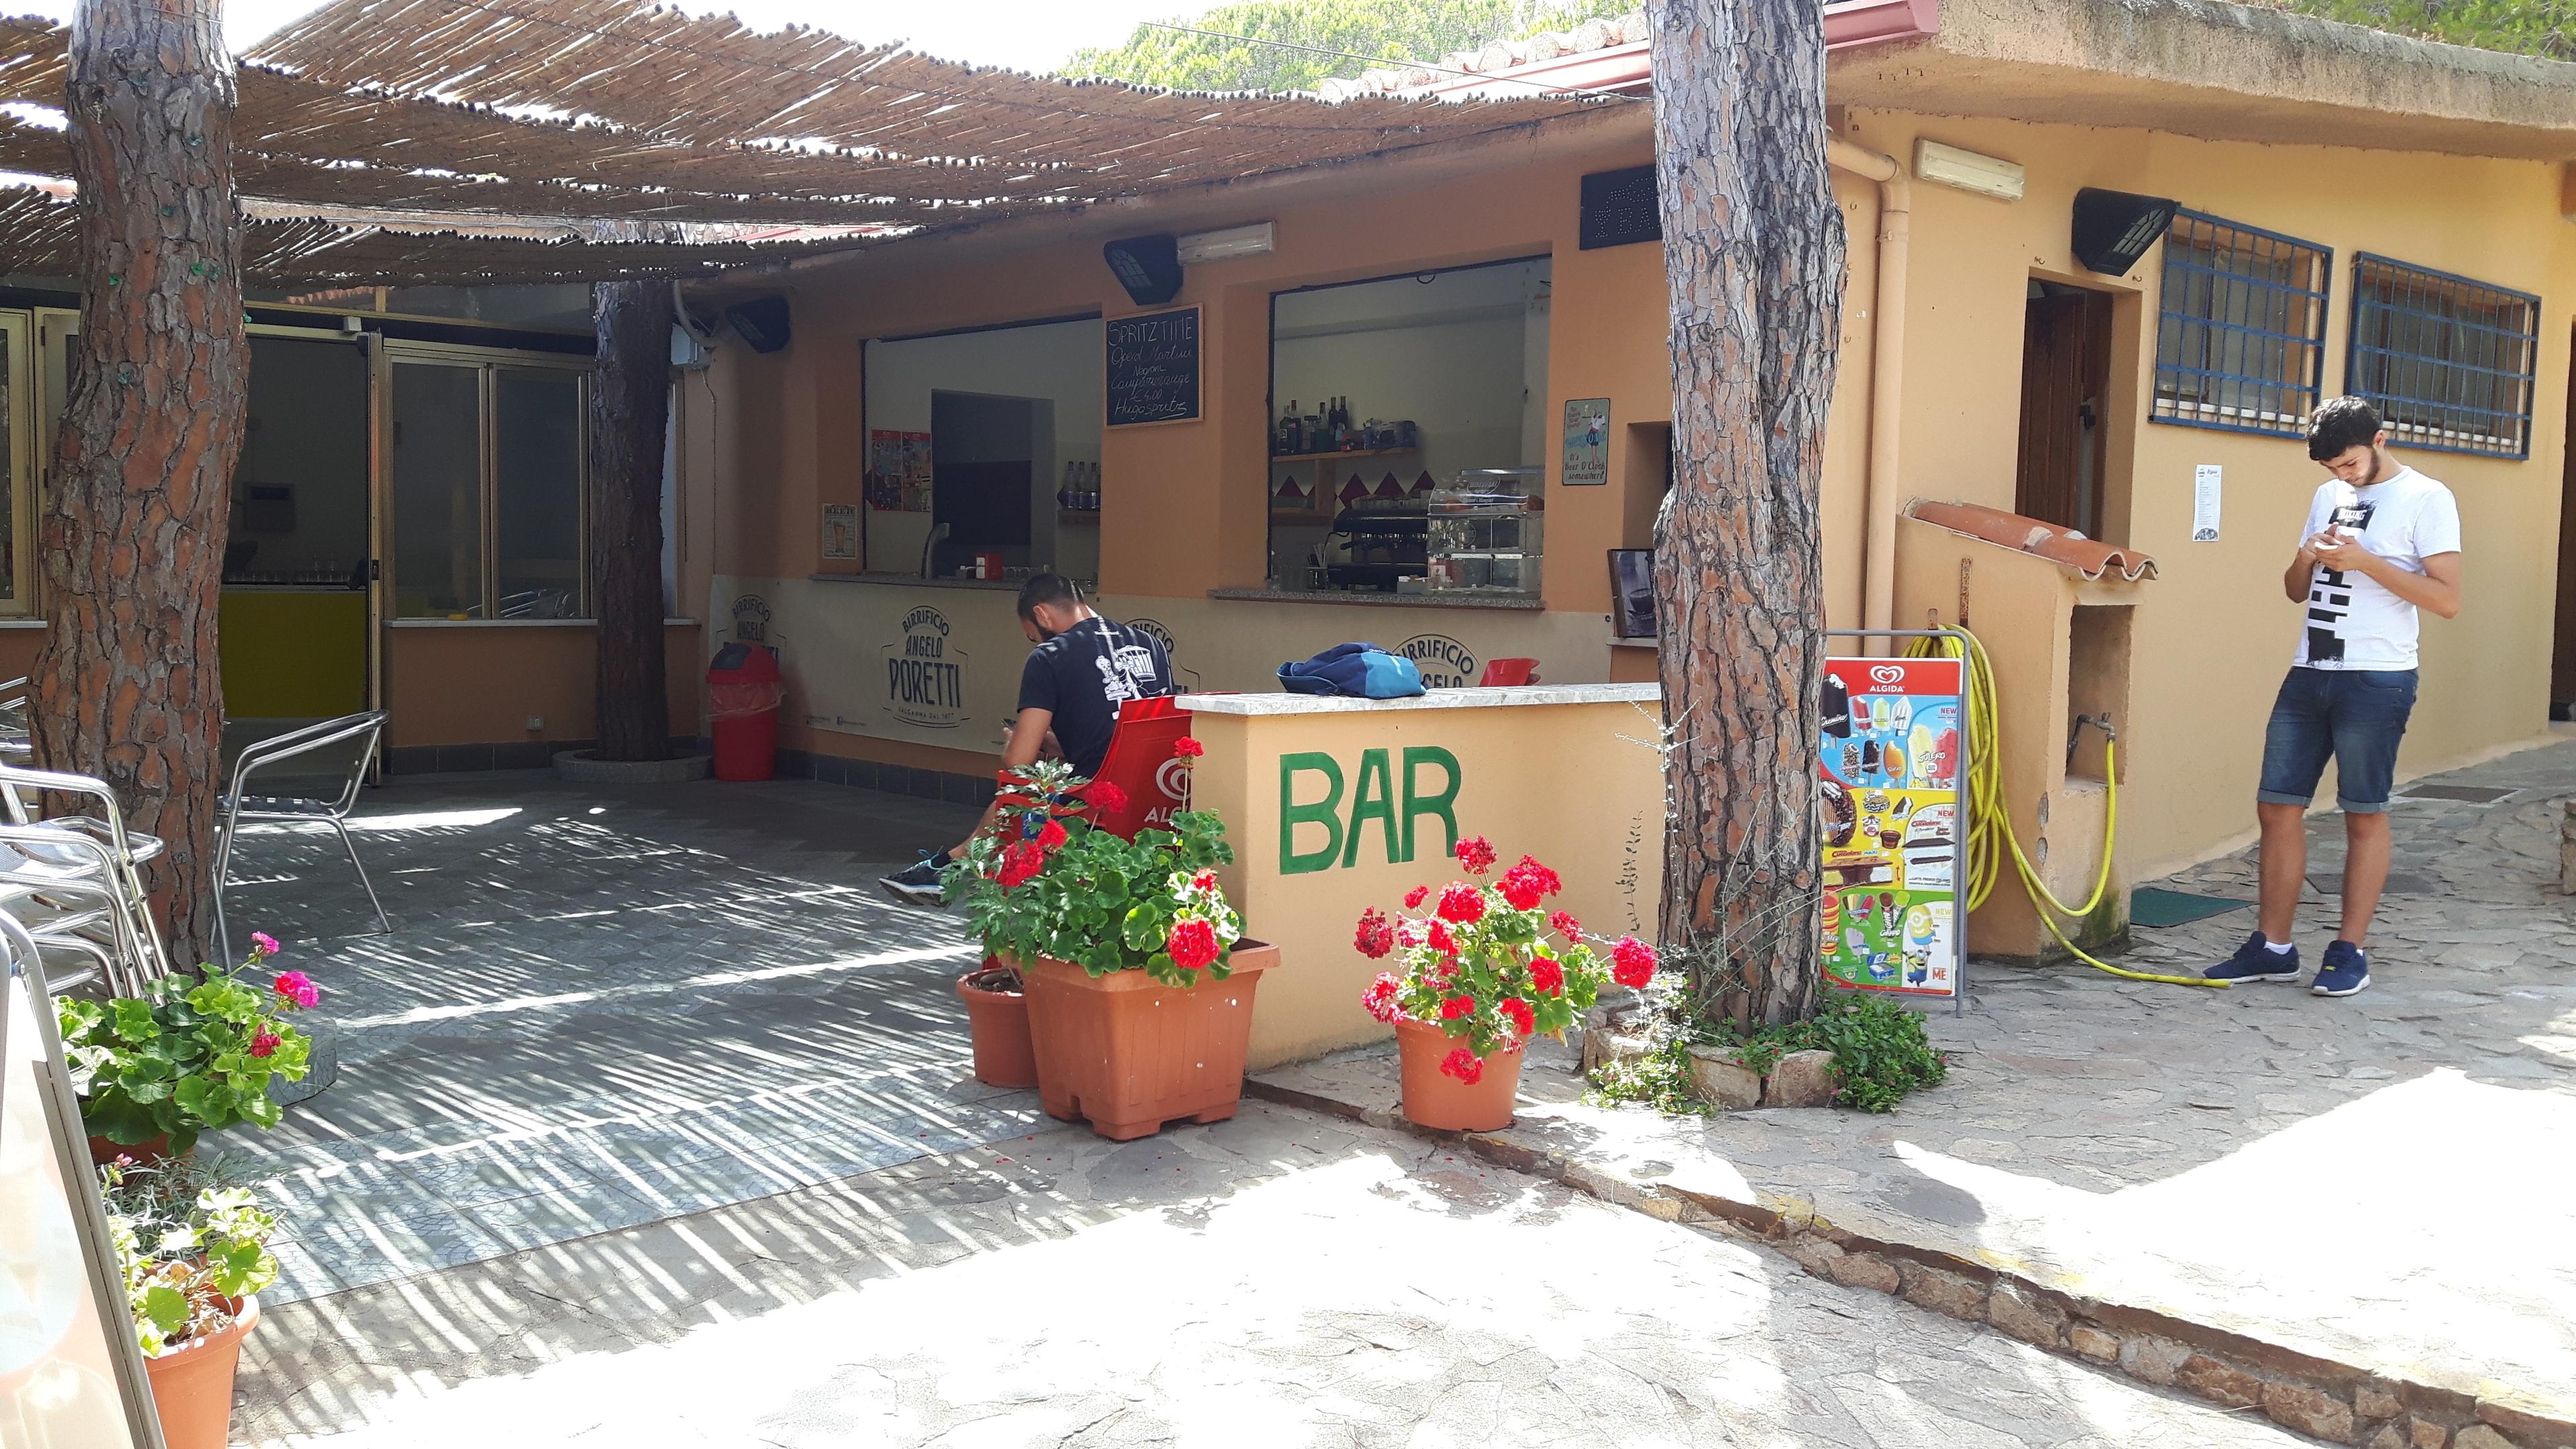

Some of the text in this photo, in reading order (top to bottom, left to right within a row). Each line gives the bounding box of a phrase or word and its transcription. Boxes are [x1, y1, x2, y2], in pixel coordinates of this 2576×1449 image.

[1108, 322, 1158, 346] SPRITZ
[732, 598, 771, 622] BIRRIFICIO
[737, 621, 765, 641] ANGELO
[902, 610, 949, 636] BIRRIFICIO
[906, 635, 943, 658] ANGELO
[1401, 639, 1473, 675] IRRIFICIO
[889, 658, 961, 708] PORETTI
[1917, 752, 1945, 763] SOLERO
[1279, 746, 1461, 875] BAR
[1933, 970, 1946, 980] ME
